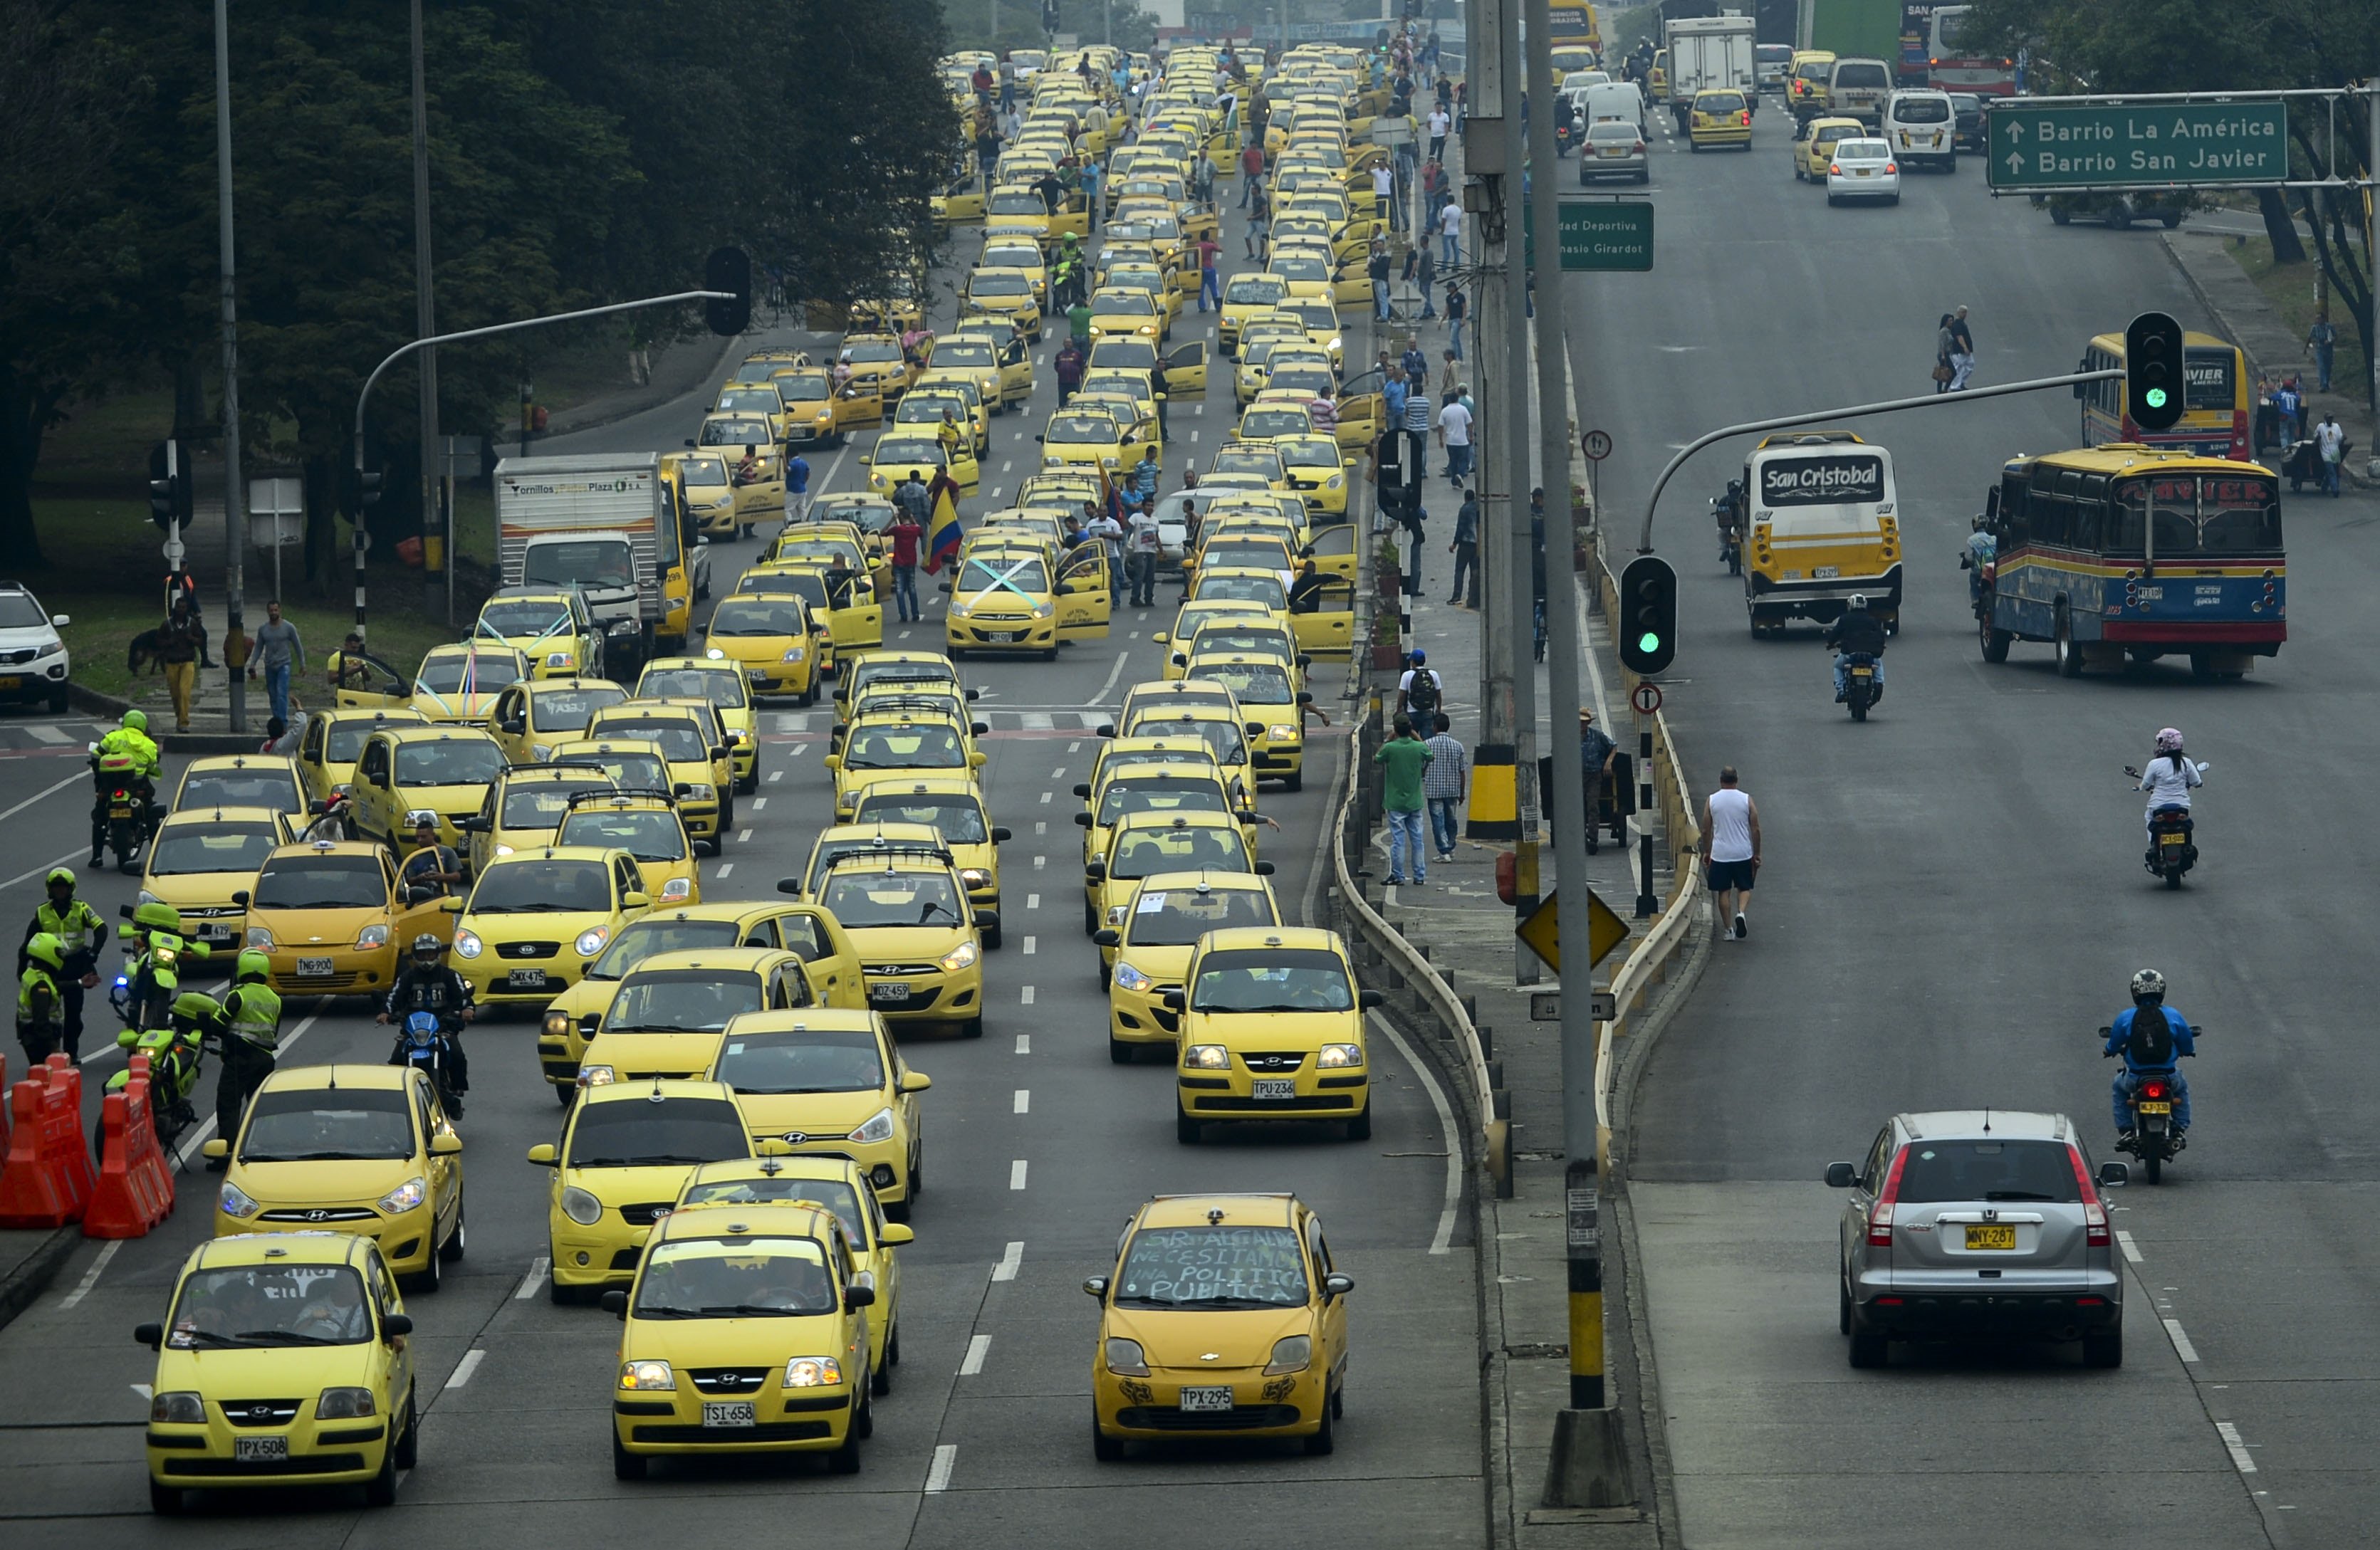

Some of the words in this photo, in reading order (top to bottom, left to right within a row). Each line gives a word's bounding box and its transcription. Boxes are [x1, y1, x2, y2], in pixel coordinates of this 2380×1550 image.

[1907, 6, 1929, 15] SAN
[2038, 121, 2114, 142] Barrio
[2129, 119, 2158, 140] La
[2171, 117, 2275, 138] América
[2039, 151, 2117, 172] Barrio
[2130, 150, 2176, 170] San
[2188, 148, 2267, 169] Javier
[1559, 221, 1577, 231] dad
[1583, 221, 1637, 232] Deportiva
[1560, 244, 1589, 253] nasio
[1594, 244, 1643, 253] Girardot
[2186, 369, 2223, 381] AVIER
[1766, 471, 1797, 488] San
[1800, 464, 1877, 487] Cristobal
[588, 482, 612, 492] Plaza
